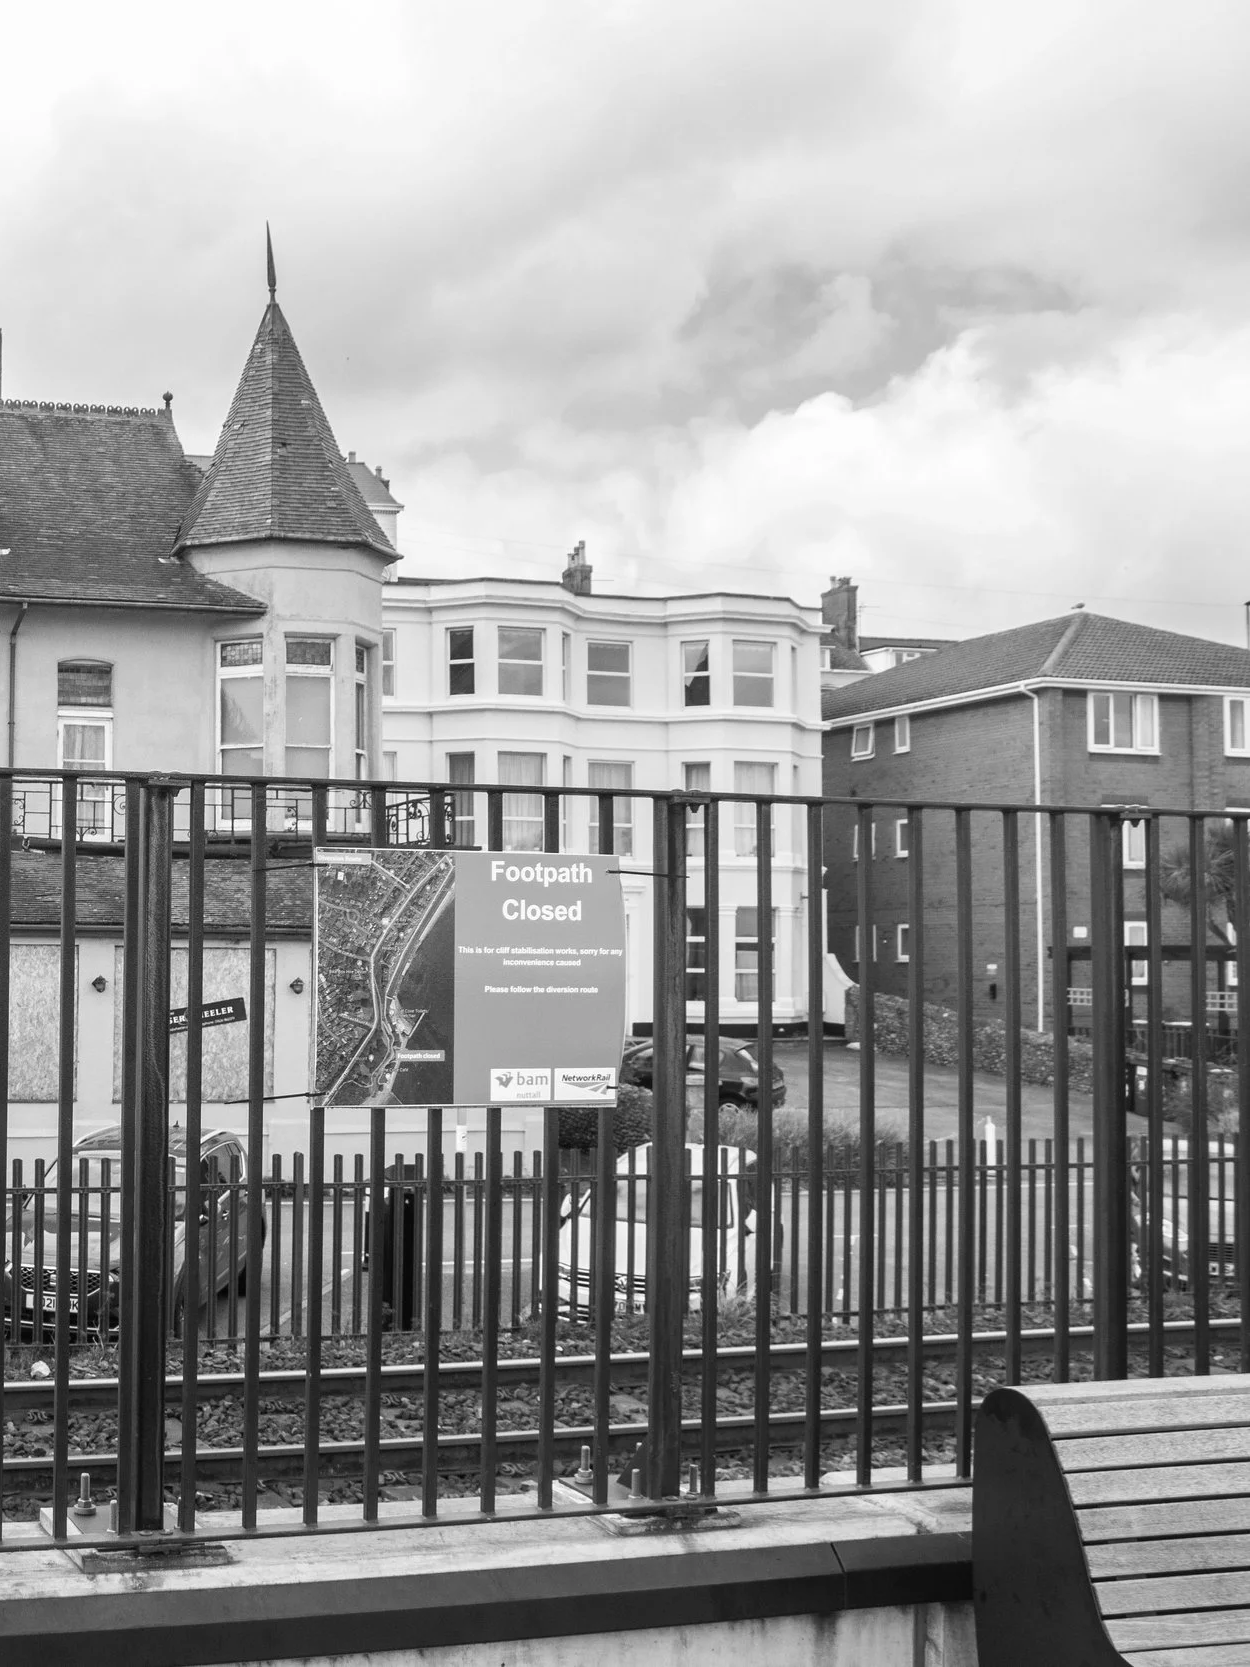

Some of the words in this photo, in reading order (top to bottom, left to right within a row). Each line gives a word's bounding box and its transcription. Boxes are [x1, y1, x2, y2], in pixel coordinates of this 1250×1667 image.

[491, 860, 593, 887] Footpath
[502, 899, 582, 921] Closed
[458, 946, 474, 954] This
[475, 946, 482, 954] is
[484, 946, 494, 954] for
[496, 946, 510, 955] cliff
[511, 946, 554, 955] stabilisation
[555, 947, 578, 956] works,
[579, 948, 597, 956] sorry
[599, 948, 610, 956] for
[610, 949, 623, 957] any
[503, 958, 554, 966] inconvenience
[484, 985, 508, 993] Please
[510, 985, 532, 993] follow
[533, 985, 545, 993] the
[397, 1052, 422, 1060] Footpath
[517, 1071, 549, 1086] bam
[516, 1091, 541, 1099] nuttall
